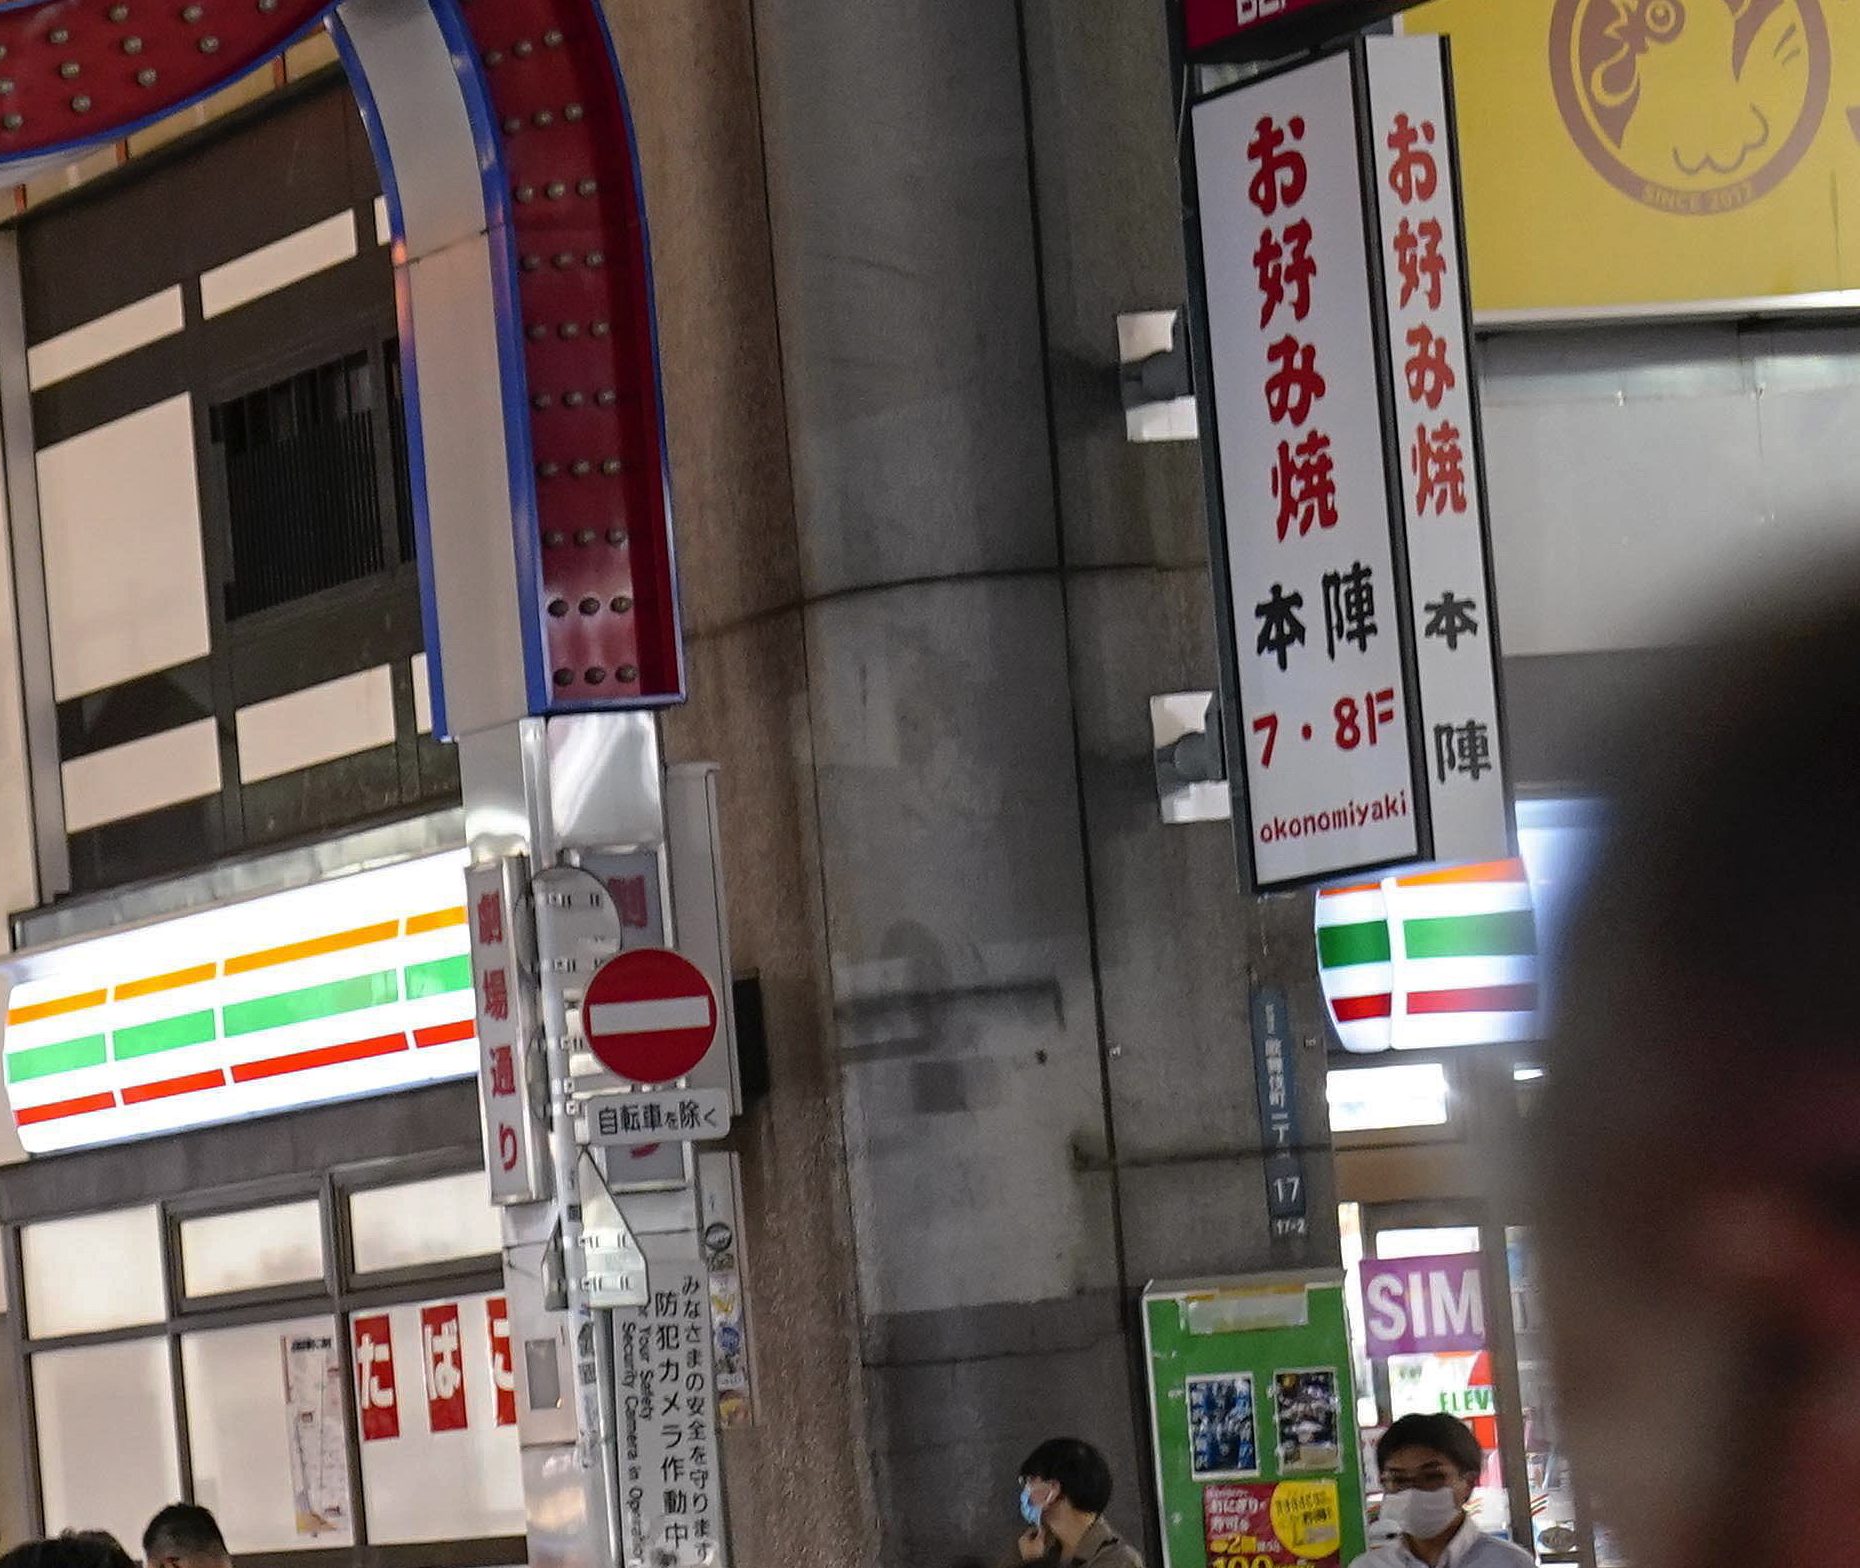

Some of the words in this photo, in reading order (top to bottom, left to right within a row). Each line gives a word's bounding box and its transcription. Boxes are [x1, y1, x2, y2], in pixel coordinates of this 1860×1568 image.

[1247, 113, 1338, 544] お好み焼
[1386, 111, 1468, 516] お好み焼
[1254, 560, 1379, 672] 本陣
[1424, 590, 1492, 785] 本陣
[1260, 794, 1409, 844] okonomiyaki
[598, 1099, 718, 1136] 自転車を除く
[1273, 1176, 1301, 1203] 17
[1367, 1268, 1485, 1341] SIM
[654, 1291, 689, 1551] 防犯カメラ作動中
[681, 1274, 712, 1566] みなさまの安全を守ります
